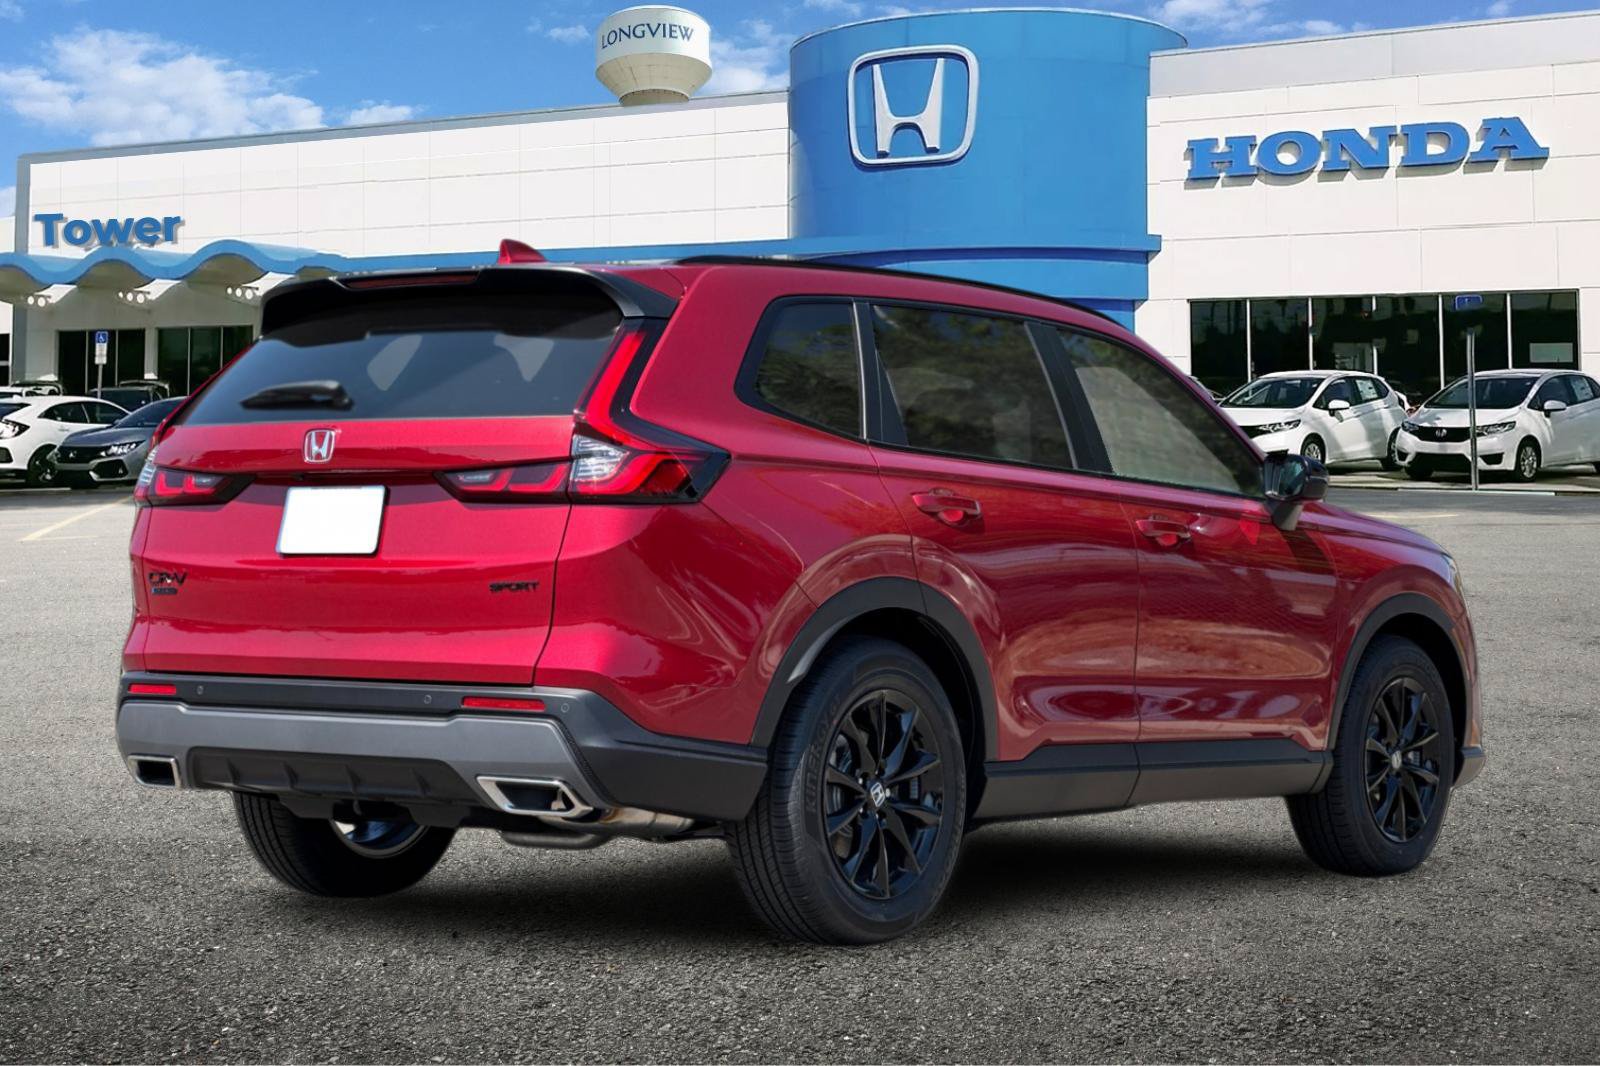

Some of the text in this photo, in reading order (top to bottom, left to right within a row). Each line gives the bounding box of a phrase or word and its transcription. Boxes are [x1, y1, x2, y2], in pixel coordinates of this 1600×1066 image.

[601, 23, 694, 49] LONGVIEW
[1185, 117, 1549, 182] HONDA
[33, 213, 181, 247] Tower
[489, 580, 539, 592] SPORT
